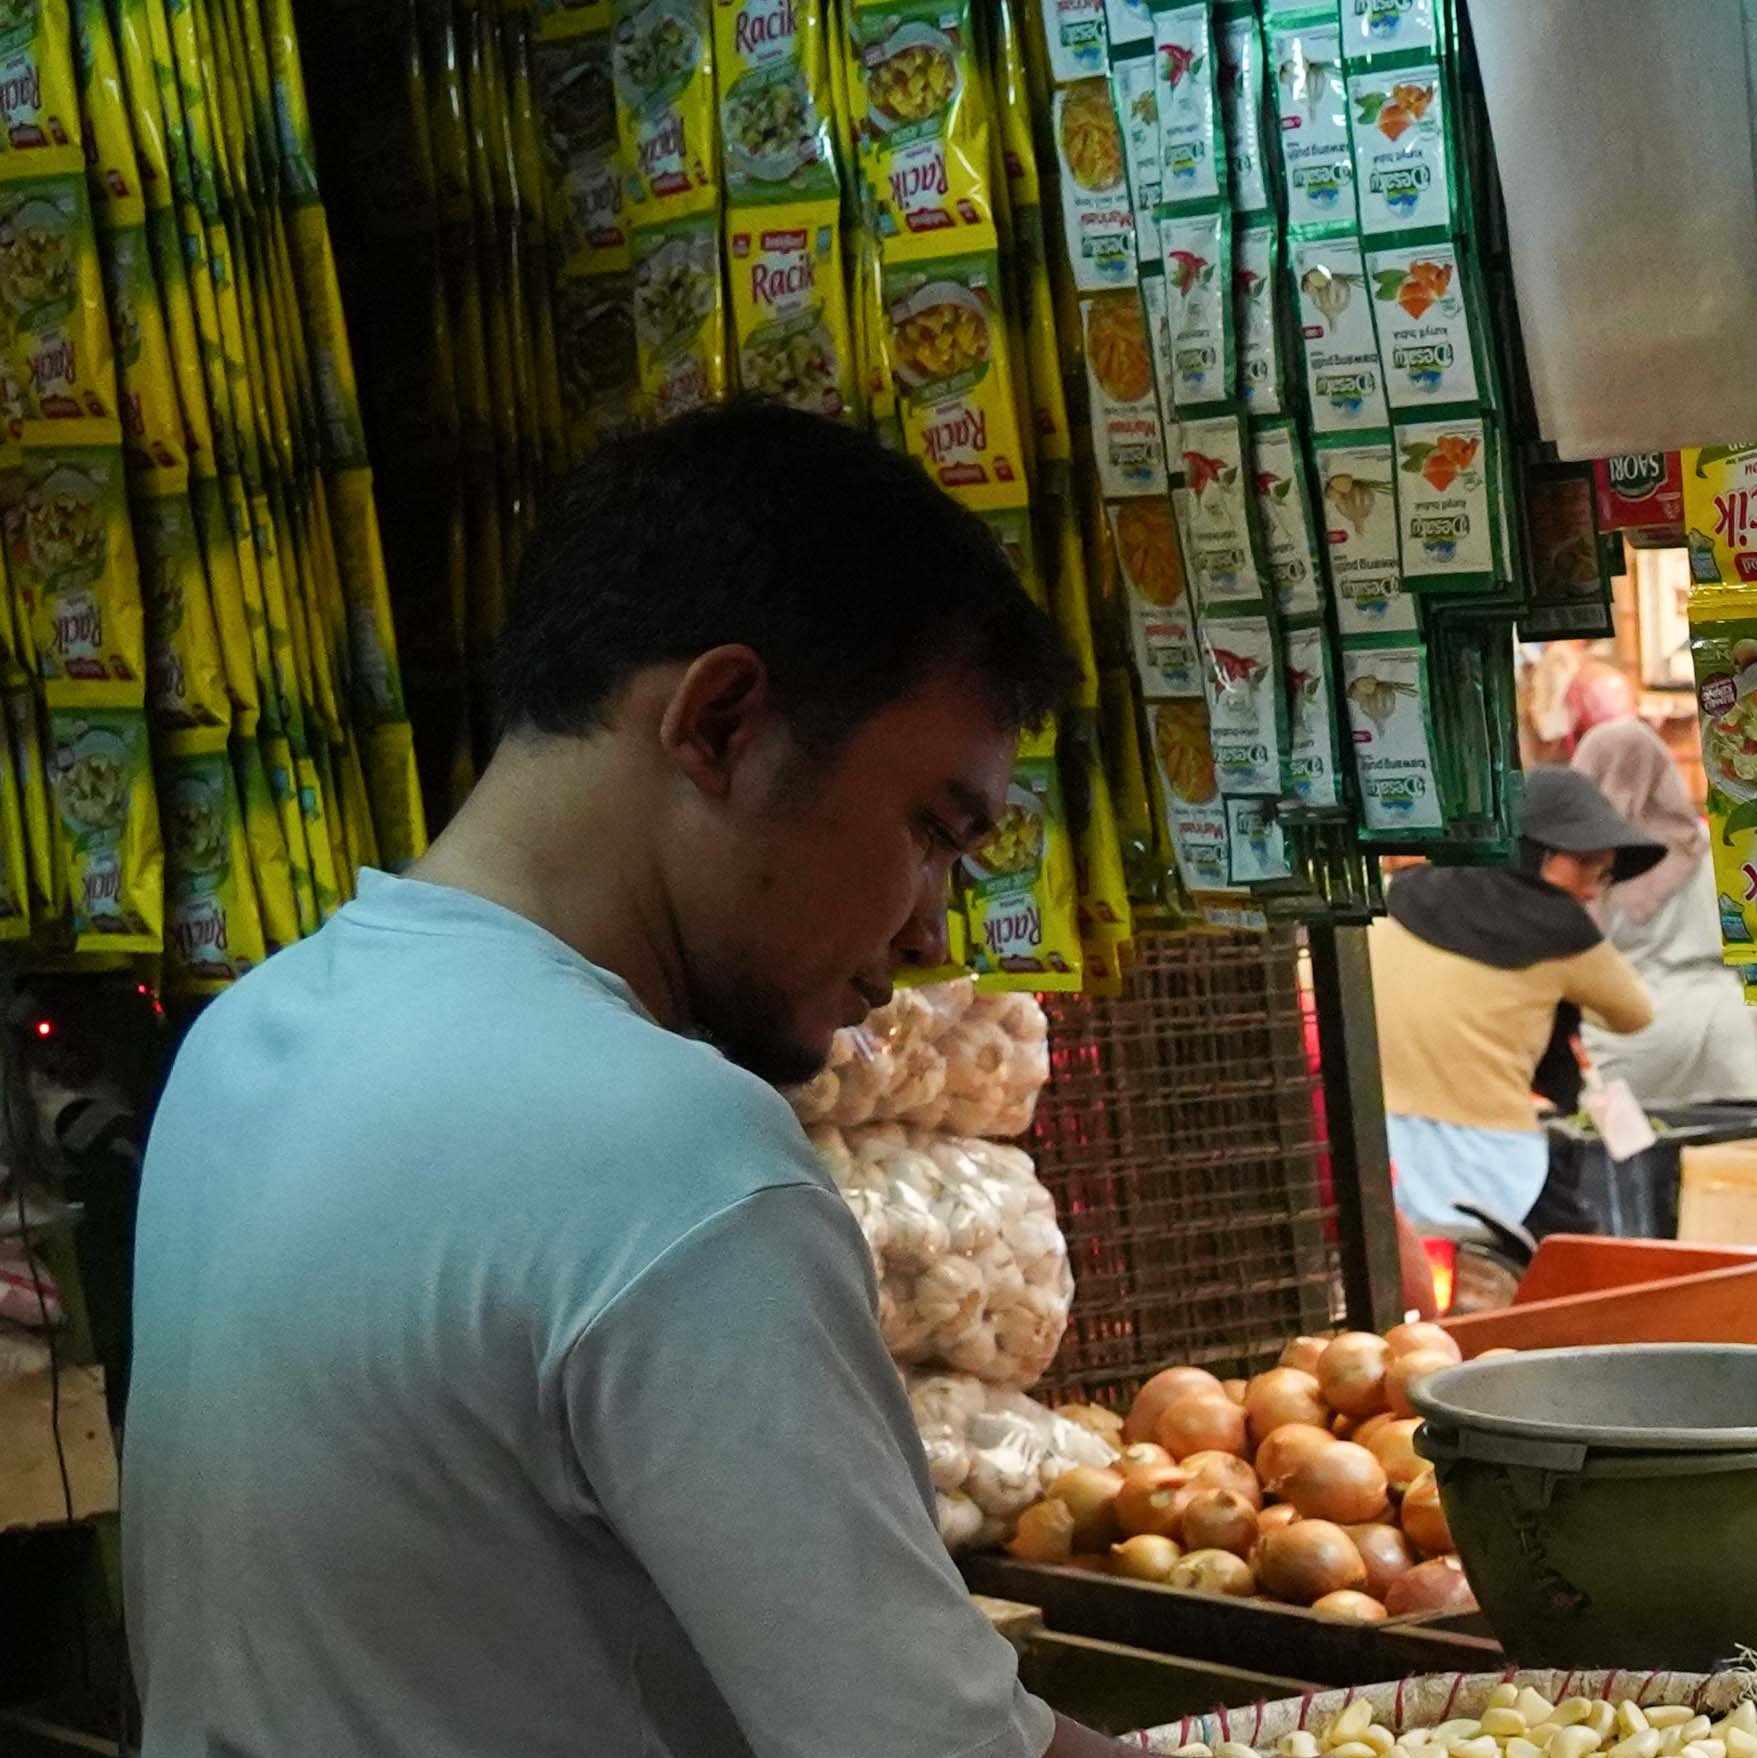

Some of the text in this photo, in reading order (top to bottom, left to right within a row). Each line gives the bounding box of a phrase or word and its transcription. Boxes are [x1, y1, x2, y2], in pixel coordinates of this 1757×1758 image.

[888, 151, 949, 209] Racik
[751, 250, 816, 304] Racik
[920, 407, 987, 464] Racik
[1609, 452, 1660, 482] SAORI
[984, 906, 1043, 954] Racik
